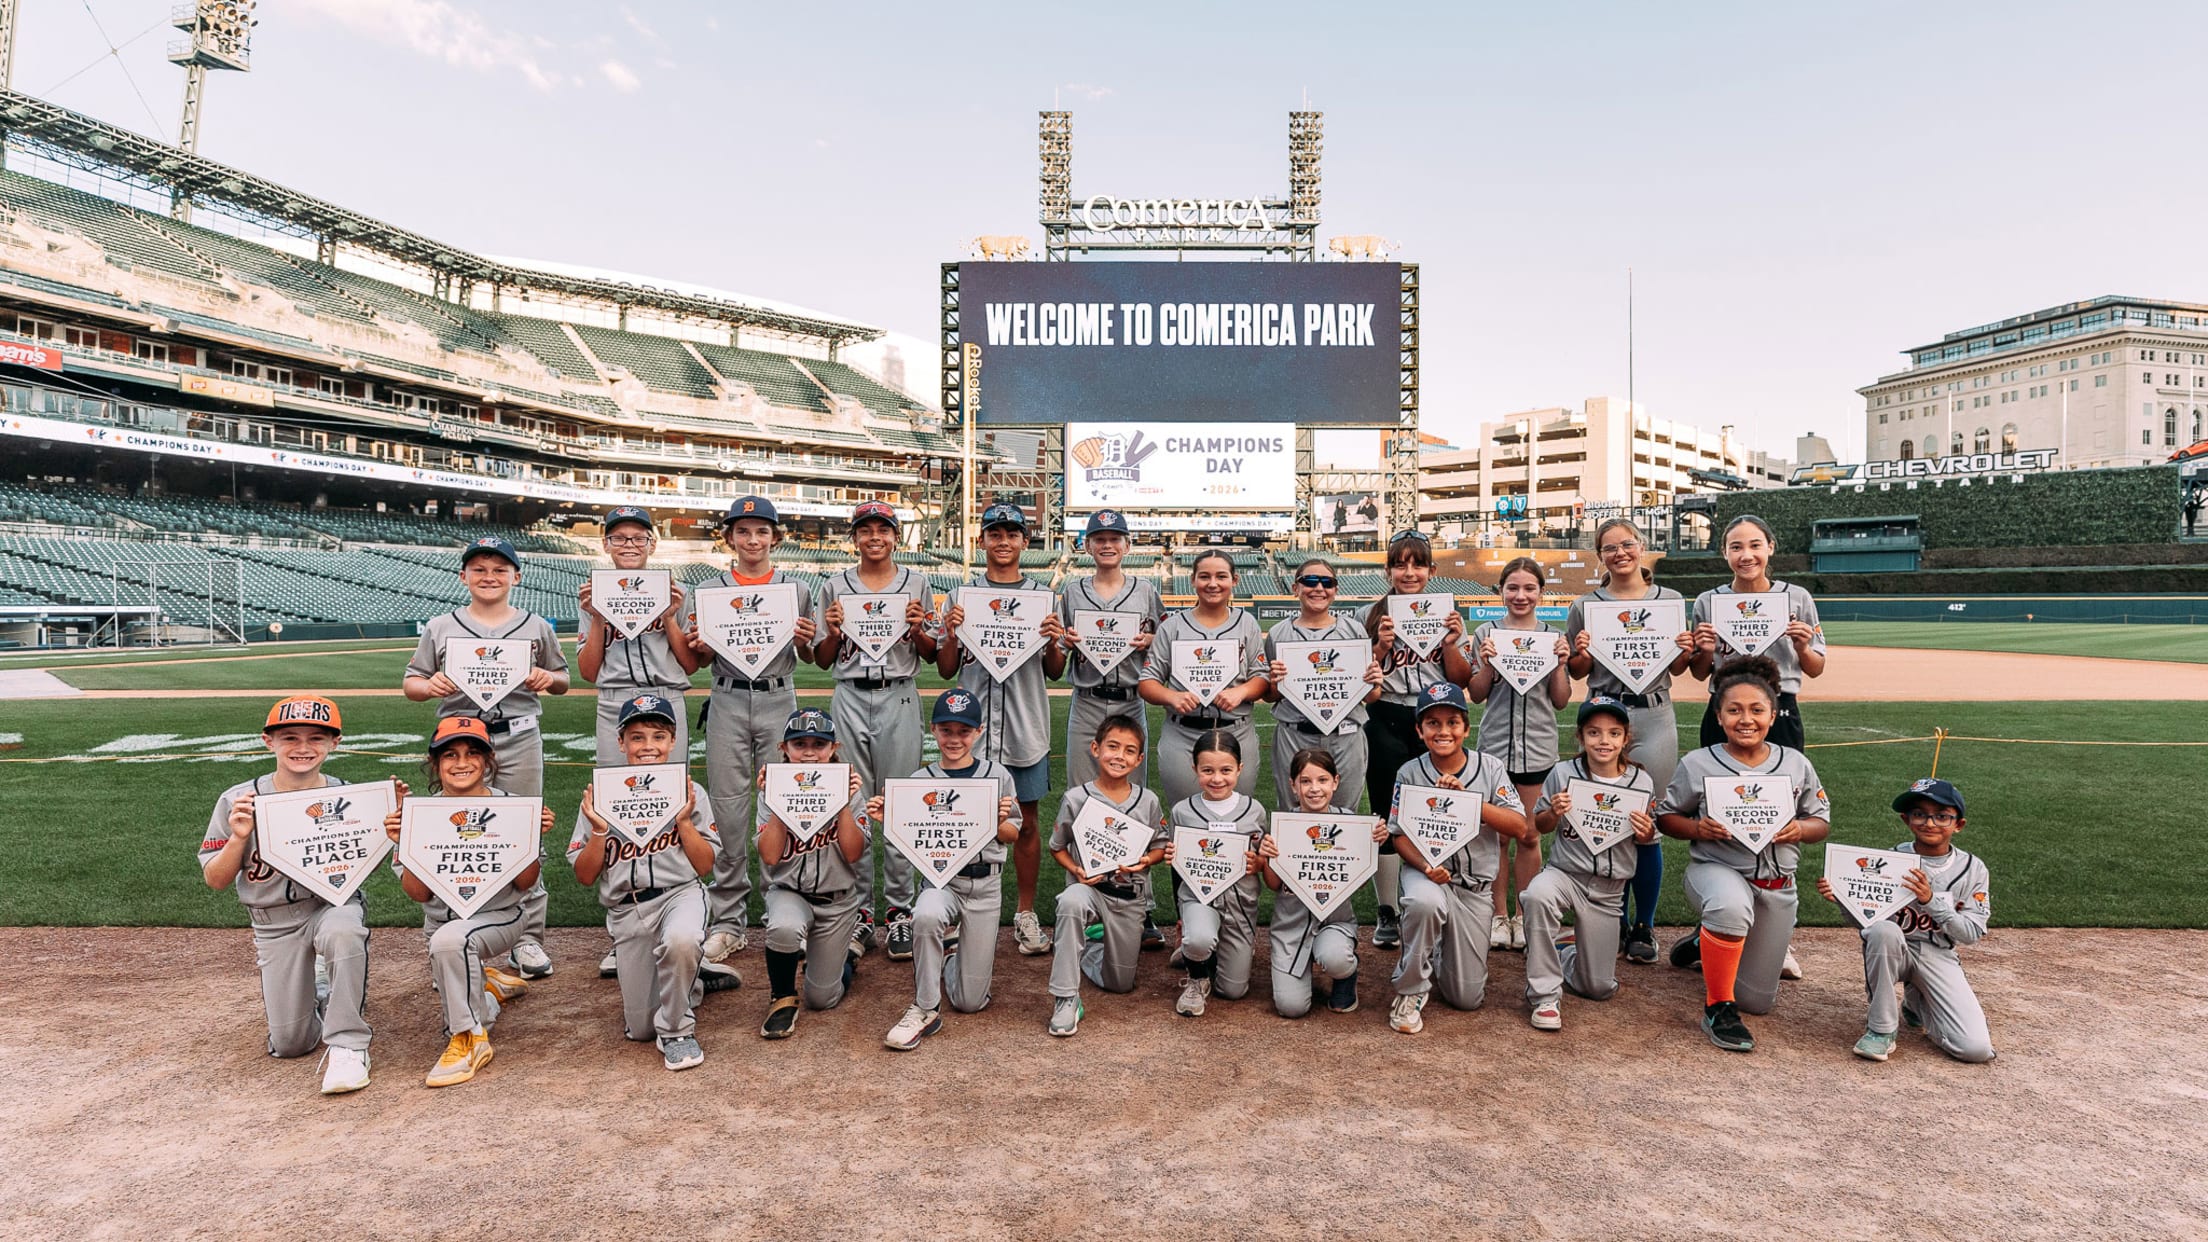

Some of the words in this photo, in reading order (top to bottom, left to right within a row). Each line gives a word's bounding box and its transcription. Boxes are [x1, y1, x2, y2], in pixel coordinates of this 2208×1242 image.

[1136, 228, 1223, 242] PARK
[985, 303, 1114, 346] WELCOME
[1121, 303, 1153, 346] TO
[1160, 303, 1297, 346] COMERICA
[1304, 303, 1375, 346] PARK
[970, 359, 982, 411] Rocket
[127, 435, 189, 451] CHAMPIONS
[192, 443, 213, 454] DAY
[1165, 437, 1284, 454] CHAMPIONS
[301, 458, 350, 471] CHAMPIONS
[351, 464, 368, 473] DAY
[1206, 458, 1244, 473] DAY
[1864, 449, 2059, 480] CHEVROLET
[1092, 469, 1133, 480] BASEBALL
[1210, 484, 1239, 494] 2026
[1830, 474, 2025, 495] FOUNTAIN
[1401, 622, 1442, 630] SECOND
[729, 627, 771, 637] FIRST
[983, 630, 1024, 640] FIRST
[1406, 628, 1439, 636] PLACE
[727, 636, 775, 646] PLACE
[980, 639, 1025, 649] PLACE
[1615, 642, 1658, 651] FIRST
[1612, 651, 1661, 660] PLACE
[1501, 658, 1545, 666] SECOND
[1306, 682, 1346, 691] FIRST
[1304, 691, 1349, 700] PLACE
[279, 702, 331, 722] TIGERS
[612, 801, 670, 813] SECOND
[786, 805, 827, 813] PLACE
[619, 810, 664, 820] PLACE
[1584, 813, 1622, 827] THIRD
[1419, 822, 1458, 833] THIRD
[1582, 820, 1621, 834] PLACE
[290, 831, 350, 845] CHAMPIONS
[353, 828, 372, 836] DAY
[917, 829, 965, 838] FIRST
[1417, 830, 1457, 841] PLACE
[305, 838, 363, 855] FIRST
[914, 839, 968, 849] PLACE
[1083, 831, 1127, 857] SECOND
[1085, 840, 1120, 862] PLACE
[302, 848, 368, 867] PLACE
[441, 852, 500, 862] FIRST
[323, 864, 350, 874] 2026
[436, 863, 502, 874] PLACE
[1185, 862, 1232, 873] SECOND
[1301, 861, 1347, 872] FIRST
[455, 876, 481, 884] 2026
[1190, 869, 1226, 880] PLACE
[1298, 871, 1349, 882] PLACE
[1842, 877, 1883, 886] CHAMPIONS
[1848, 883, 1893, 895] THIRD
[1848, 891, 1893, 903] PLACE
